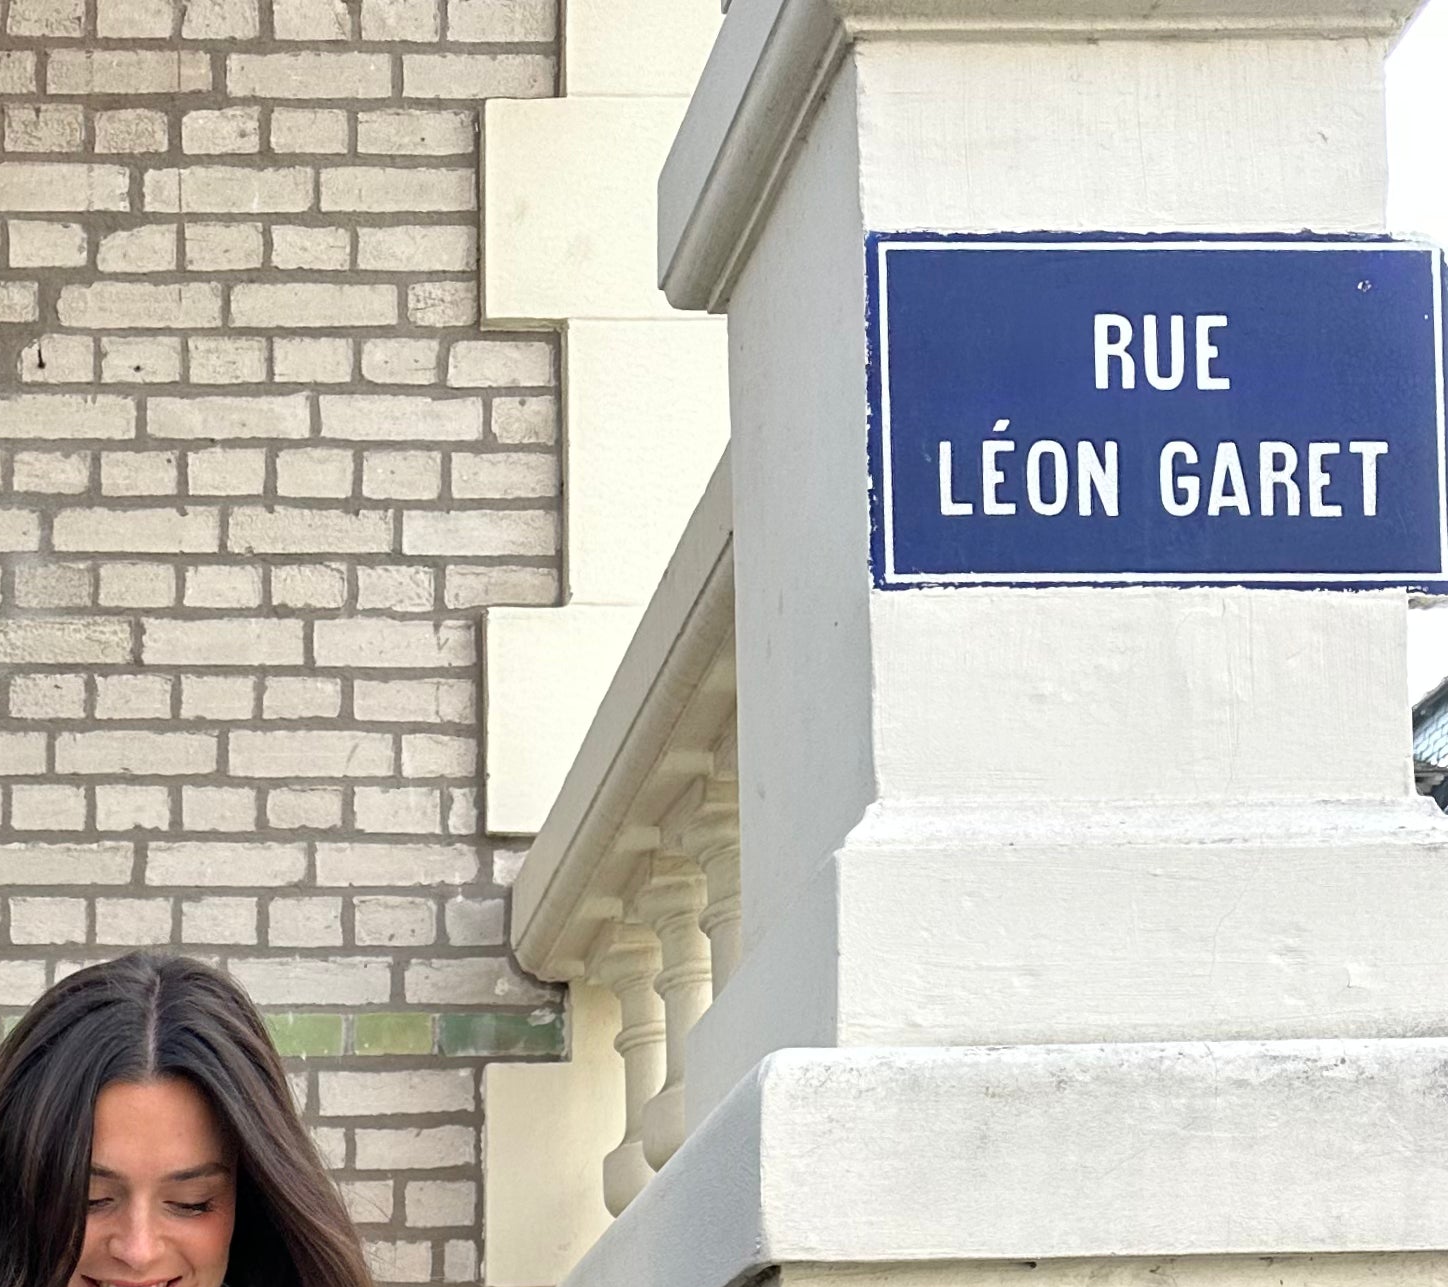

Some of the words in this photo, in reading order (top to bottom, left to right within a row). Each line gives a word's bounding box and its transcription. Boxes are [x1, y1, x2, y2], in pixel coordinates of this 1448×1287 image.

[1093, 313, 1231, 391] RUE
[938, 418, 1119, 517] LÉON
[1159, 440, 1389, 517] GARET
